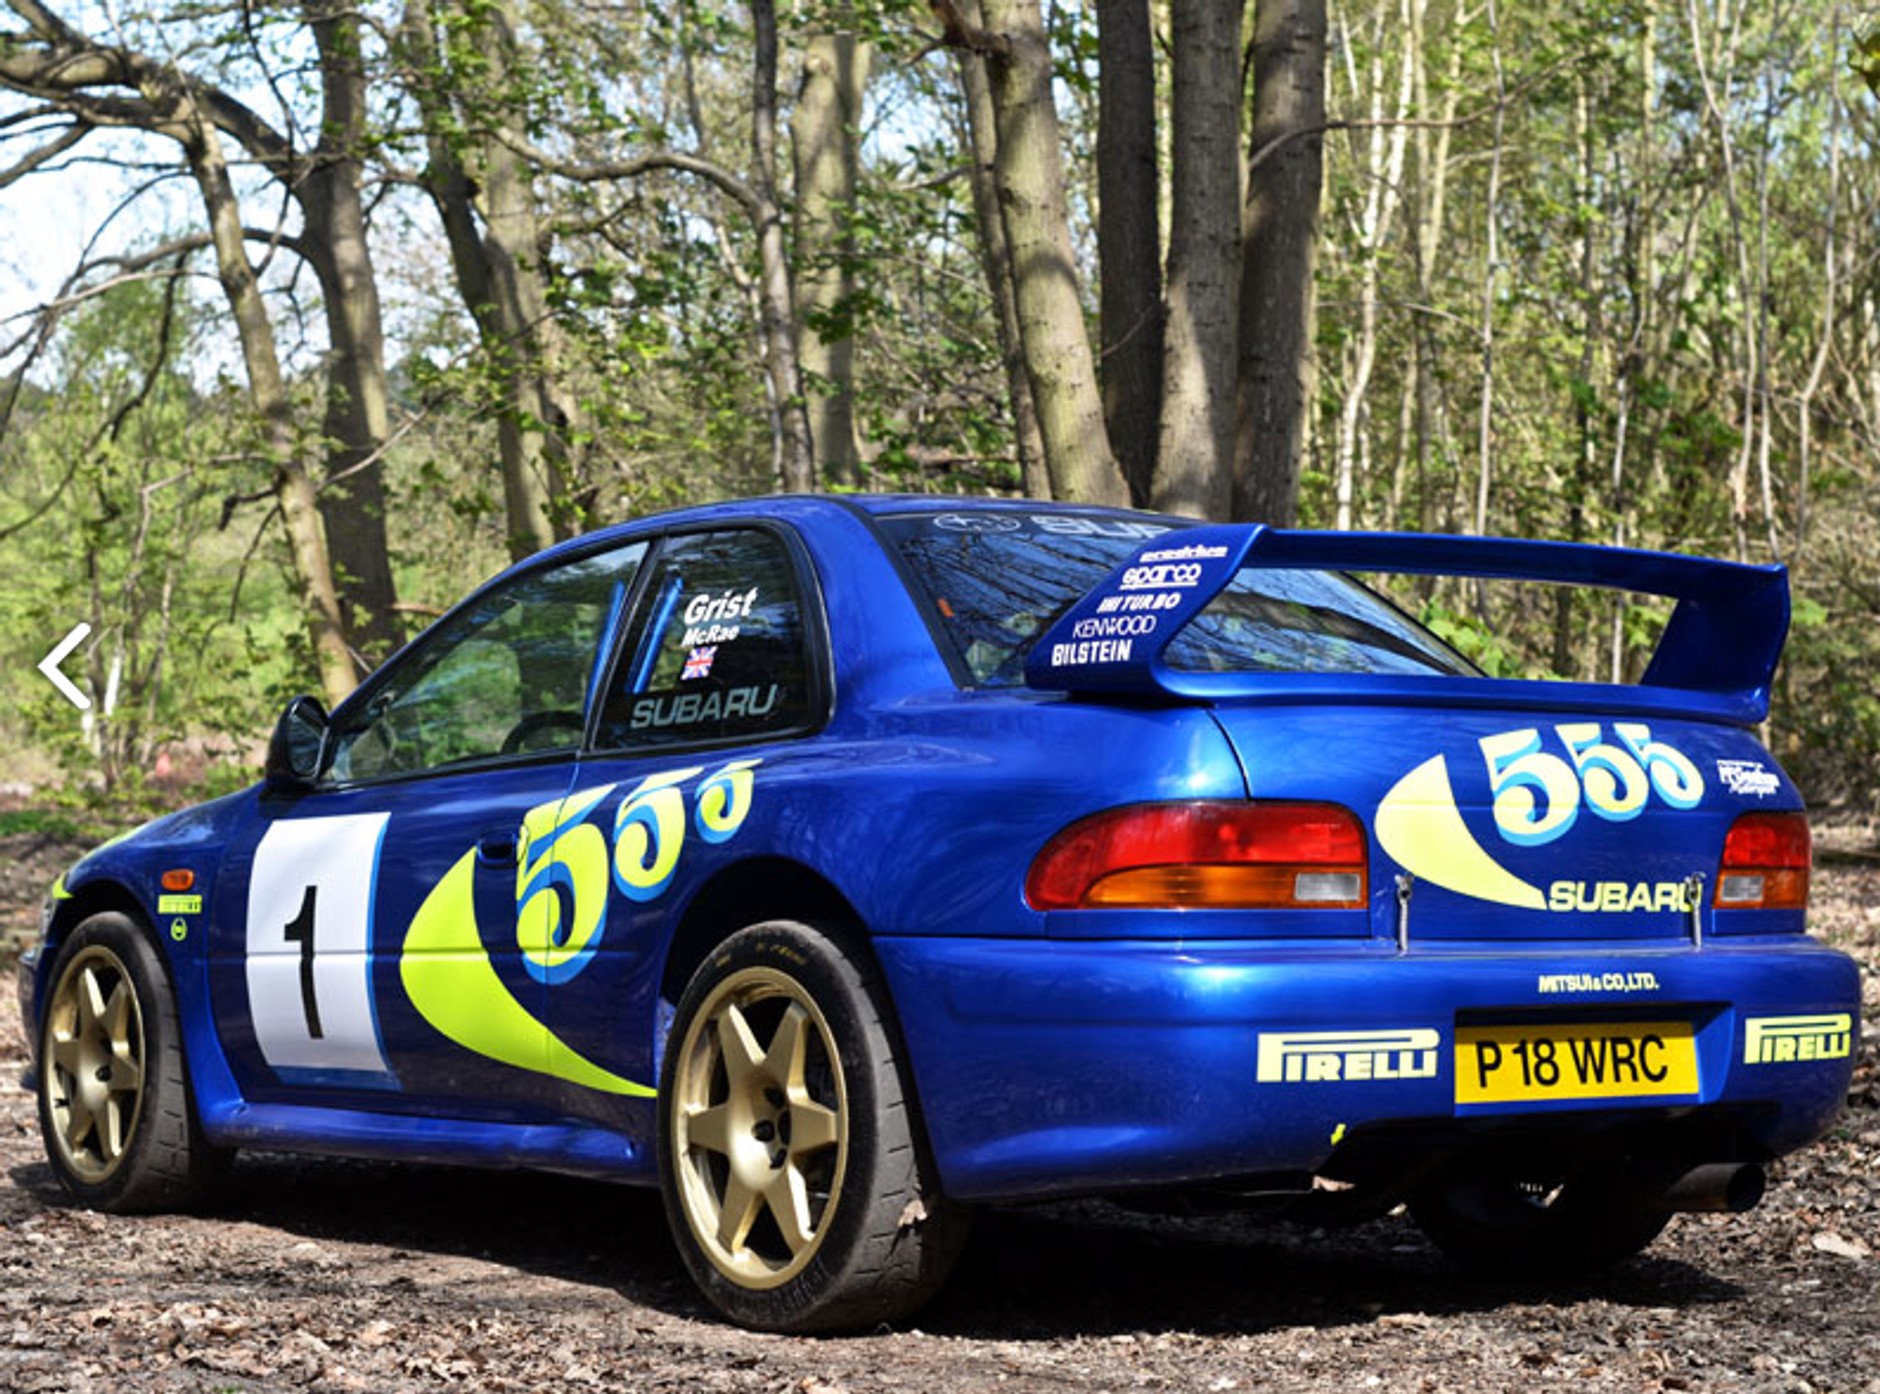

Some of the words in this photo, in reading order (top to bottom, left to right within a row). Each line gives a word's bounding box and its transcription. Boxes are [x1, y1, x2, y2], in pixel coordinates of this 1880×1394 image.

[1120, 563, 1202, 588] sparco
[684, 587, 759, 625] Grist
[1072, 615, 1157, 639] KENWOOD
[680, 625, 740, 647] McRae
[1051, 639, 1133, 667] BILSTEIN
[630, 684, 778, 729] SUBARU
[1478, 722, 1705, 847] 555
[516, 758, 763, 985] 555
[1549, 880, 1703, 912] SUBARU
[284, 885, 324, 1039] 1
[1257, 1028, 1440, 1083] PIRELLI
[1475, 1040, 1502, 1088] P
[1512, 1038, 1560, 1086] 18
[1568, 1034, 1668, 1084] WRC
[1744, 1013, 1852, 1064] PIRELLI
